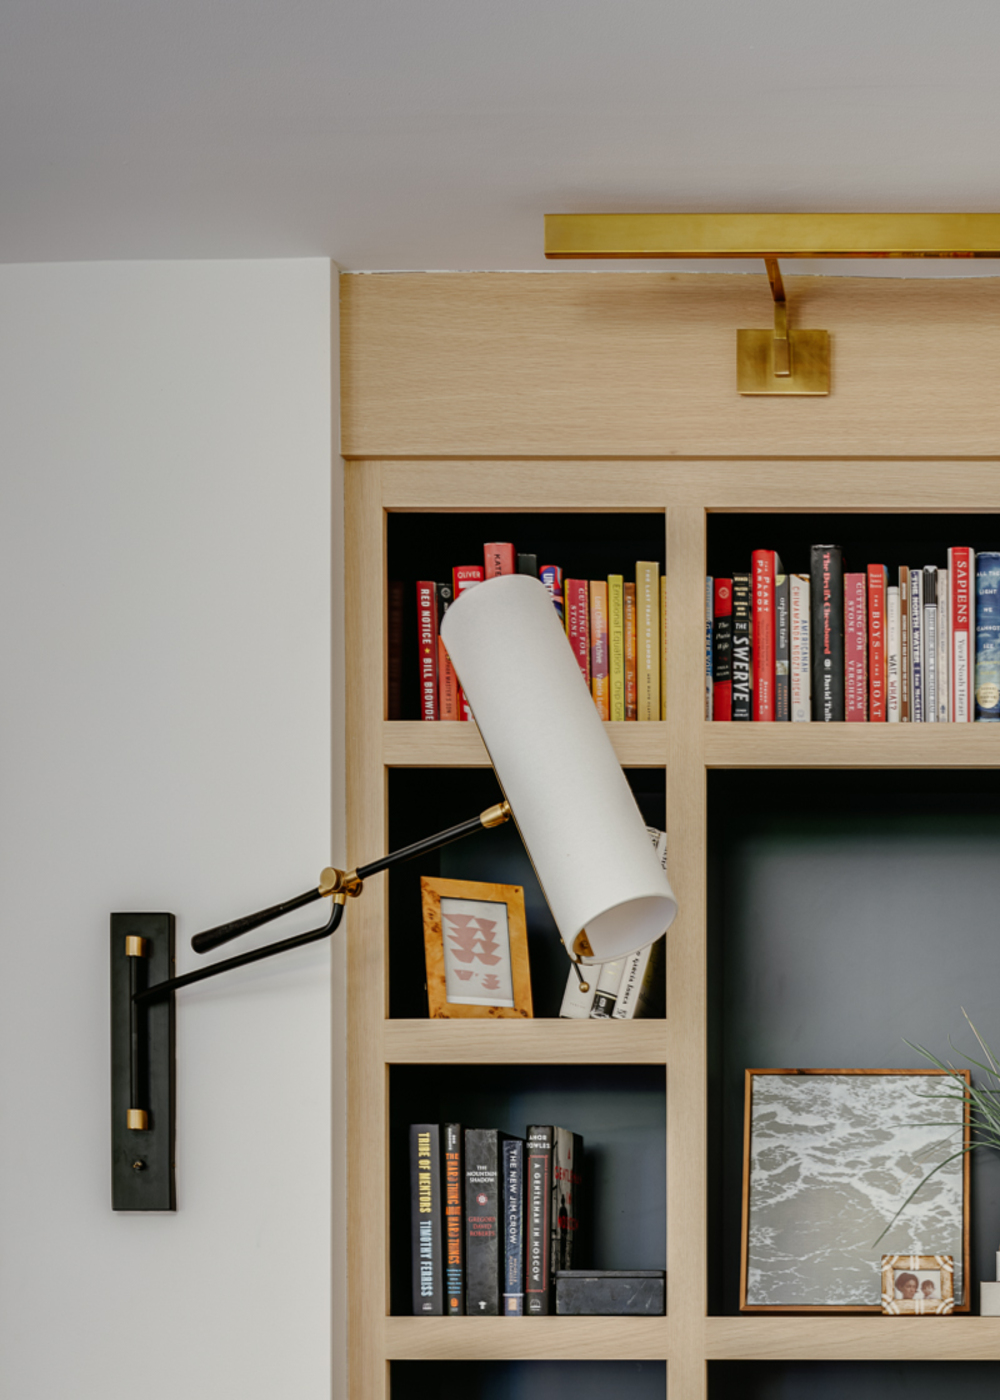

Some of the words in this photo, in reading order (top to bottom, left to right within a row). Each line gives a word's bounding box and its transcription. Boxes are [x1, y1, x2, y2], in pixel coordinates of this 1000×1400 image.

[823, 553, 831, 571] The
[457, 571, 481, 580] OLIVER
[823, 572, 831, 600] Devil's
[420, 588, 430, 607] RED
[594, 596, 603, 611] Lost
[957, 561, 967, 623] SAPIENS
[578, 588, 586, 633] CUTTING
[612, 583, 621, 628] Emotional
[777, 597, 788, 627] orphan
[792, 586, 800, 641] CHIMAMANDA
[421, 610, 432, 644] NOTICE
[570, 604, 578, 638] STONE
[594, 611, 603, 638] Children
[645, 628, 652, 638] TO
[823, 602, 831, 655] Chessboard
[872, 611, 880, 647] BOYS
[579, 636, 587, 656] FOR
[779, 628, 788, 648] train
[957, 640, 965, 661] Yuval
[594, 640, 603, 664] Archive
[612, 630, 622, 675] Equations
[792, 645, 800, 670] NGOZI
[423, 657, 433, 679] BILL
[733, 635, 749, 702] SWERVE
[957, 664, 965, 686] Noah
[612, 680, 622, 700] Chip
[792, 673, 800, 704] ADICHIE
[823, 674, 831, 699] David
[872, 680, 881, 718] BOAT
[889, 680, 897, 711] WHAT?
[957, 689, 965, 717] Harari
[418, 1132, 431, 1157] TRIBE
[418, 1159, 431, 1170] OF
[509, 1149, 517, 1168] THE
[447, 1161, 460, 1182] HARD
[509, 1170, 517, 1194] NEW
[418, 1172, 431, 1213] MENTORS
[447, 1183, 460, 1205] THING
[509, 1195, 517, 1212] JIM
[533, 1172, 541, 1223] GENTLEMAN
[419, 1220, 433, 1259] TIMOTHY
[447, 1217, 460, 1238] HARD
[509, 1214, 517, 1244] CROW
[533, 1228, 541, 1237] IN
[447, 1239, 460, 1264] THINGS
[533, 1241, 541, 1282] MOSCOW
[419, 1261, 433, 1297] FERRISS
